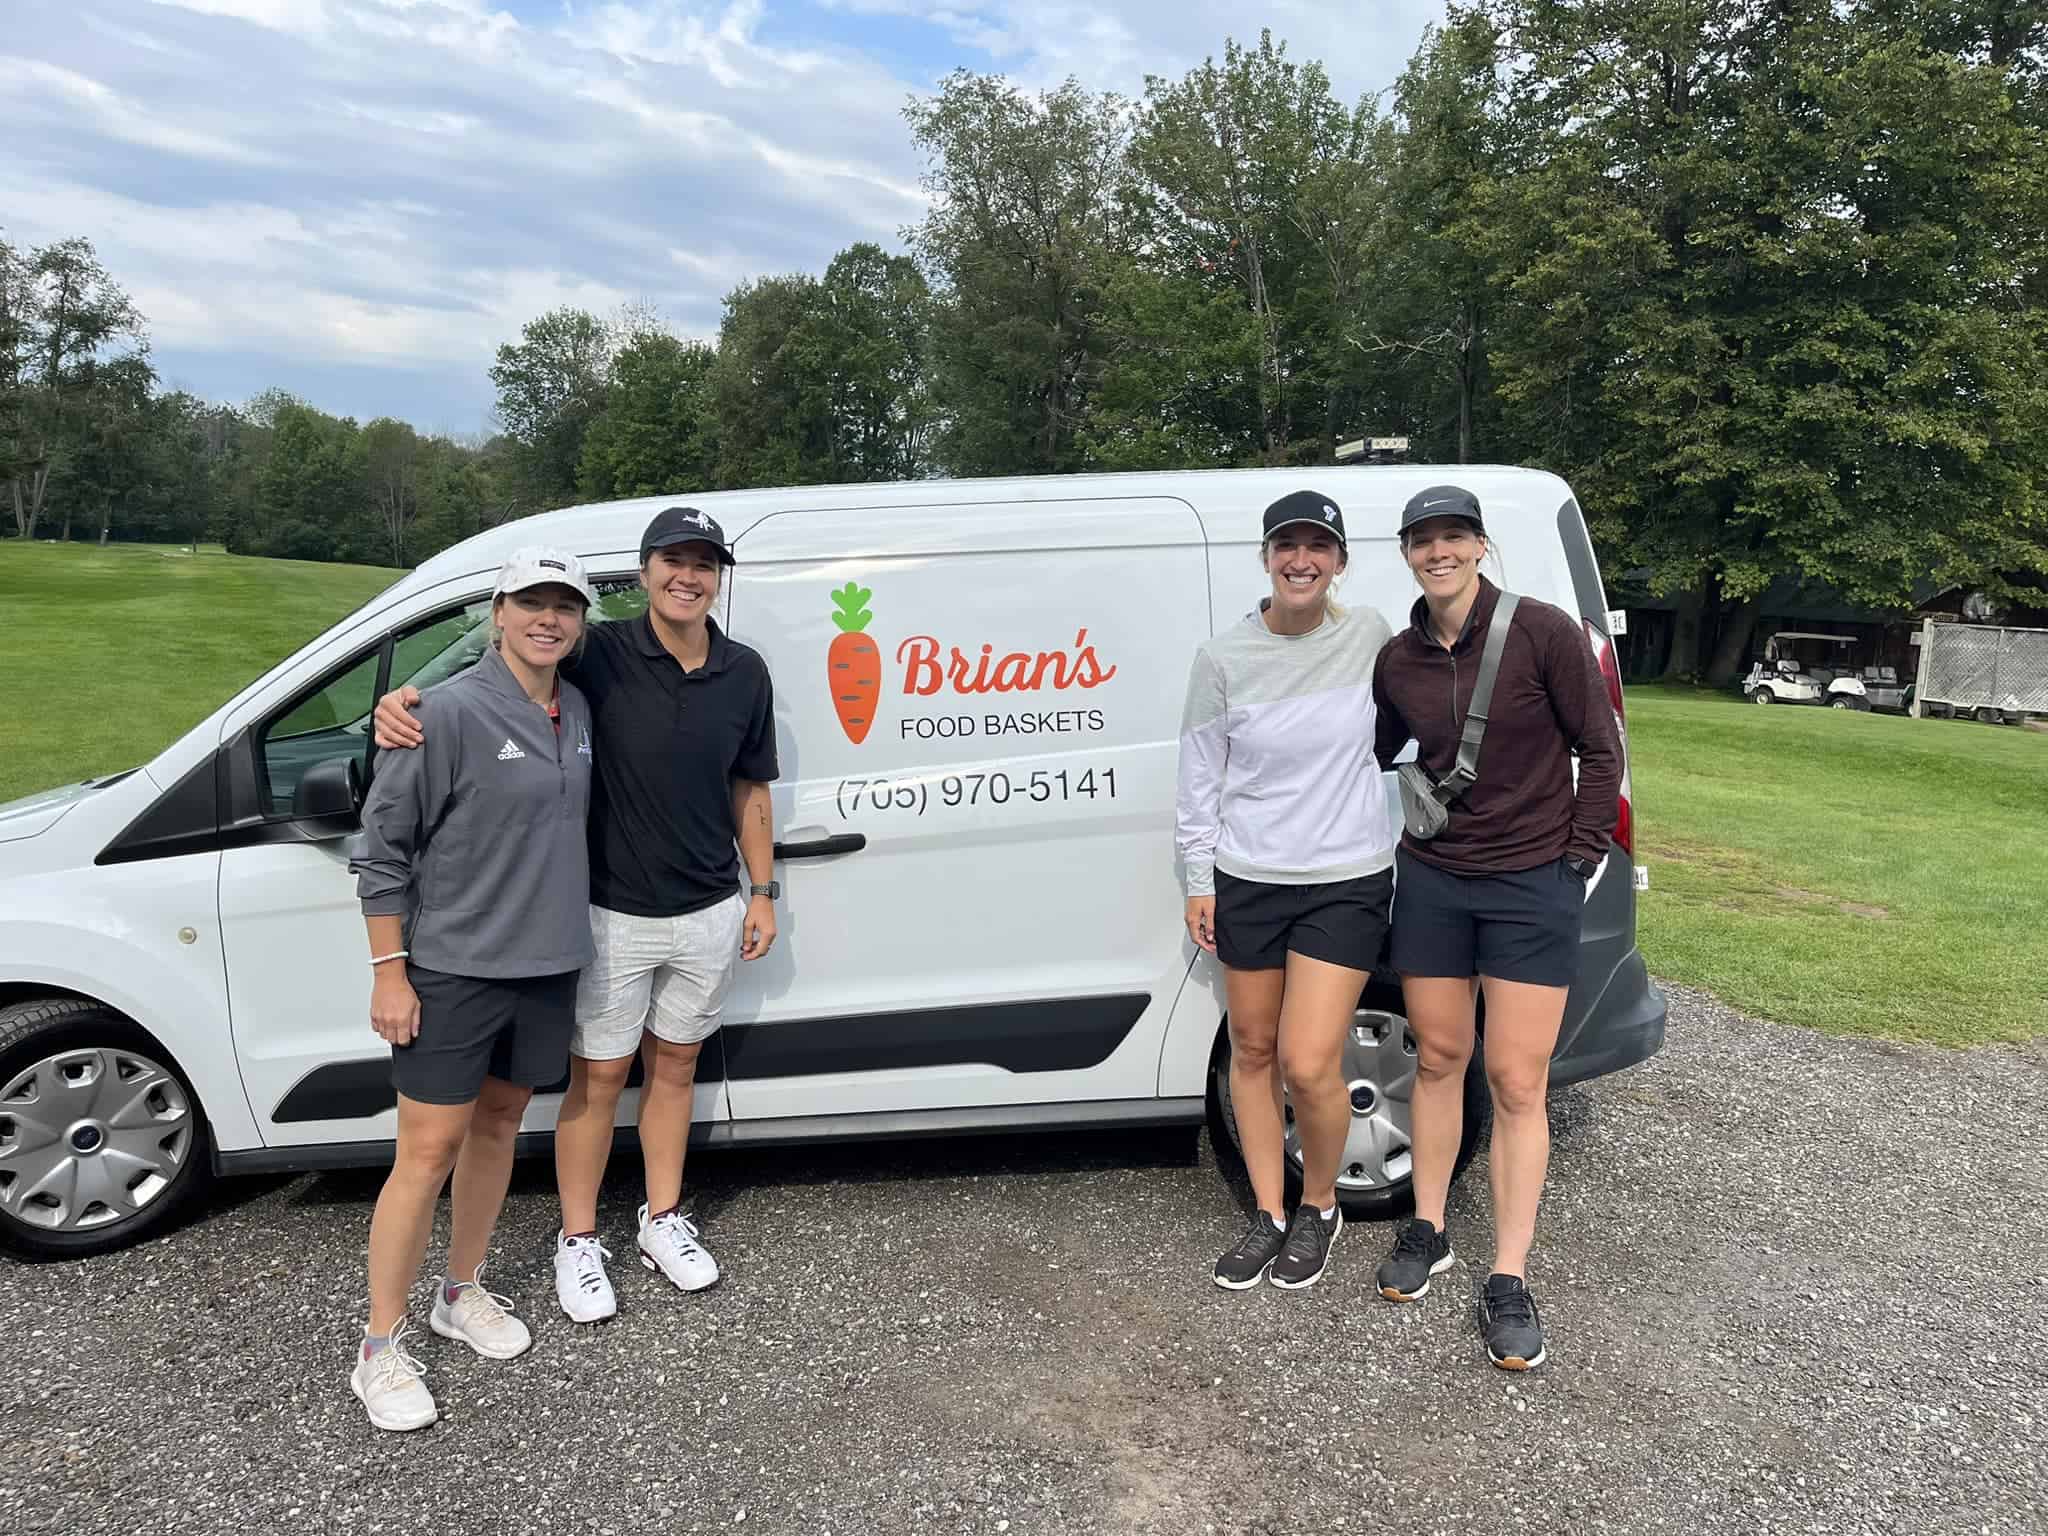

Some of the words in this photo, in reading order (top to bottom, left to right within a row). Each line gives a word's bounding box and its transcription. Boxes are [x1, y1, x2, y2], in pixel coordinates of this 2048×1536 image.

[896, 627, 1117, 696] Brian's
[901, 715, 975, 740] FOOD
[984, 709, 1105, 736] BASKETS
[497, 751, 526, 761] adidas
[836, 778, 928, 819] (705)
[941, 768, 1118, 806] 970-5141
